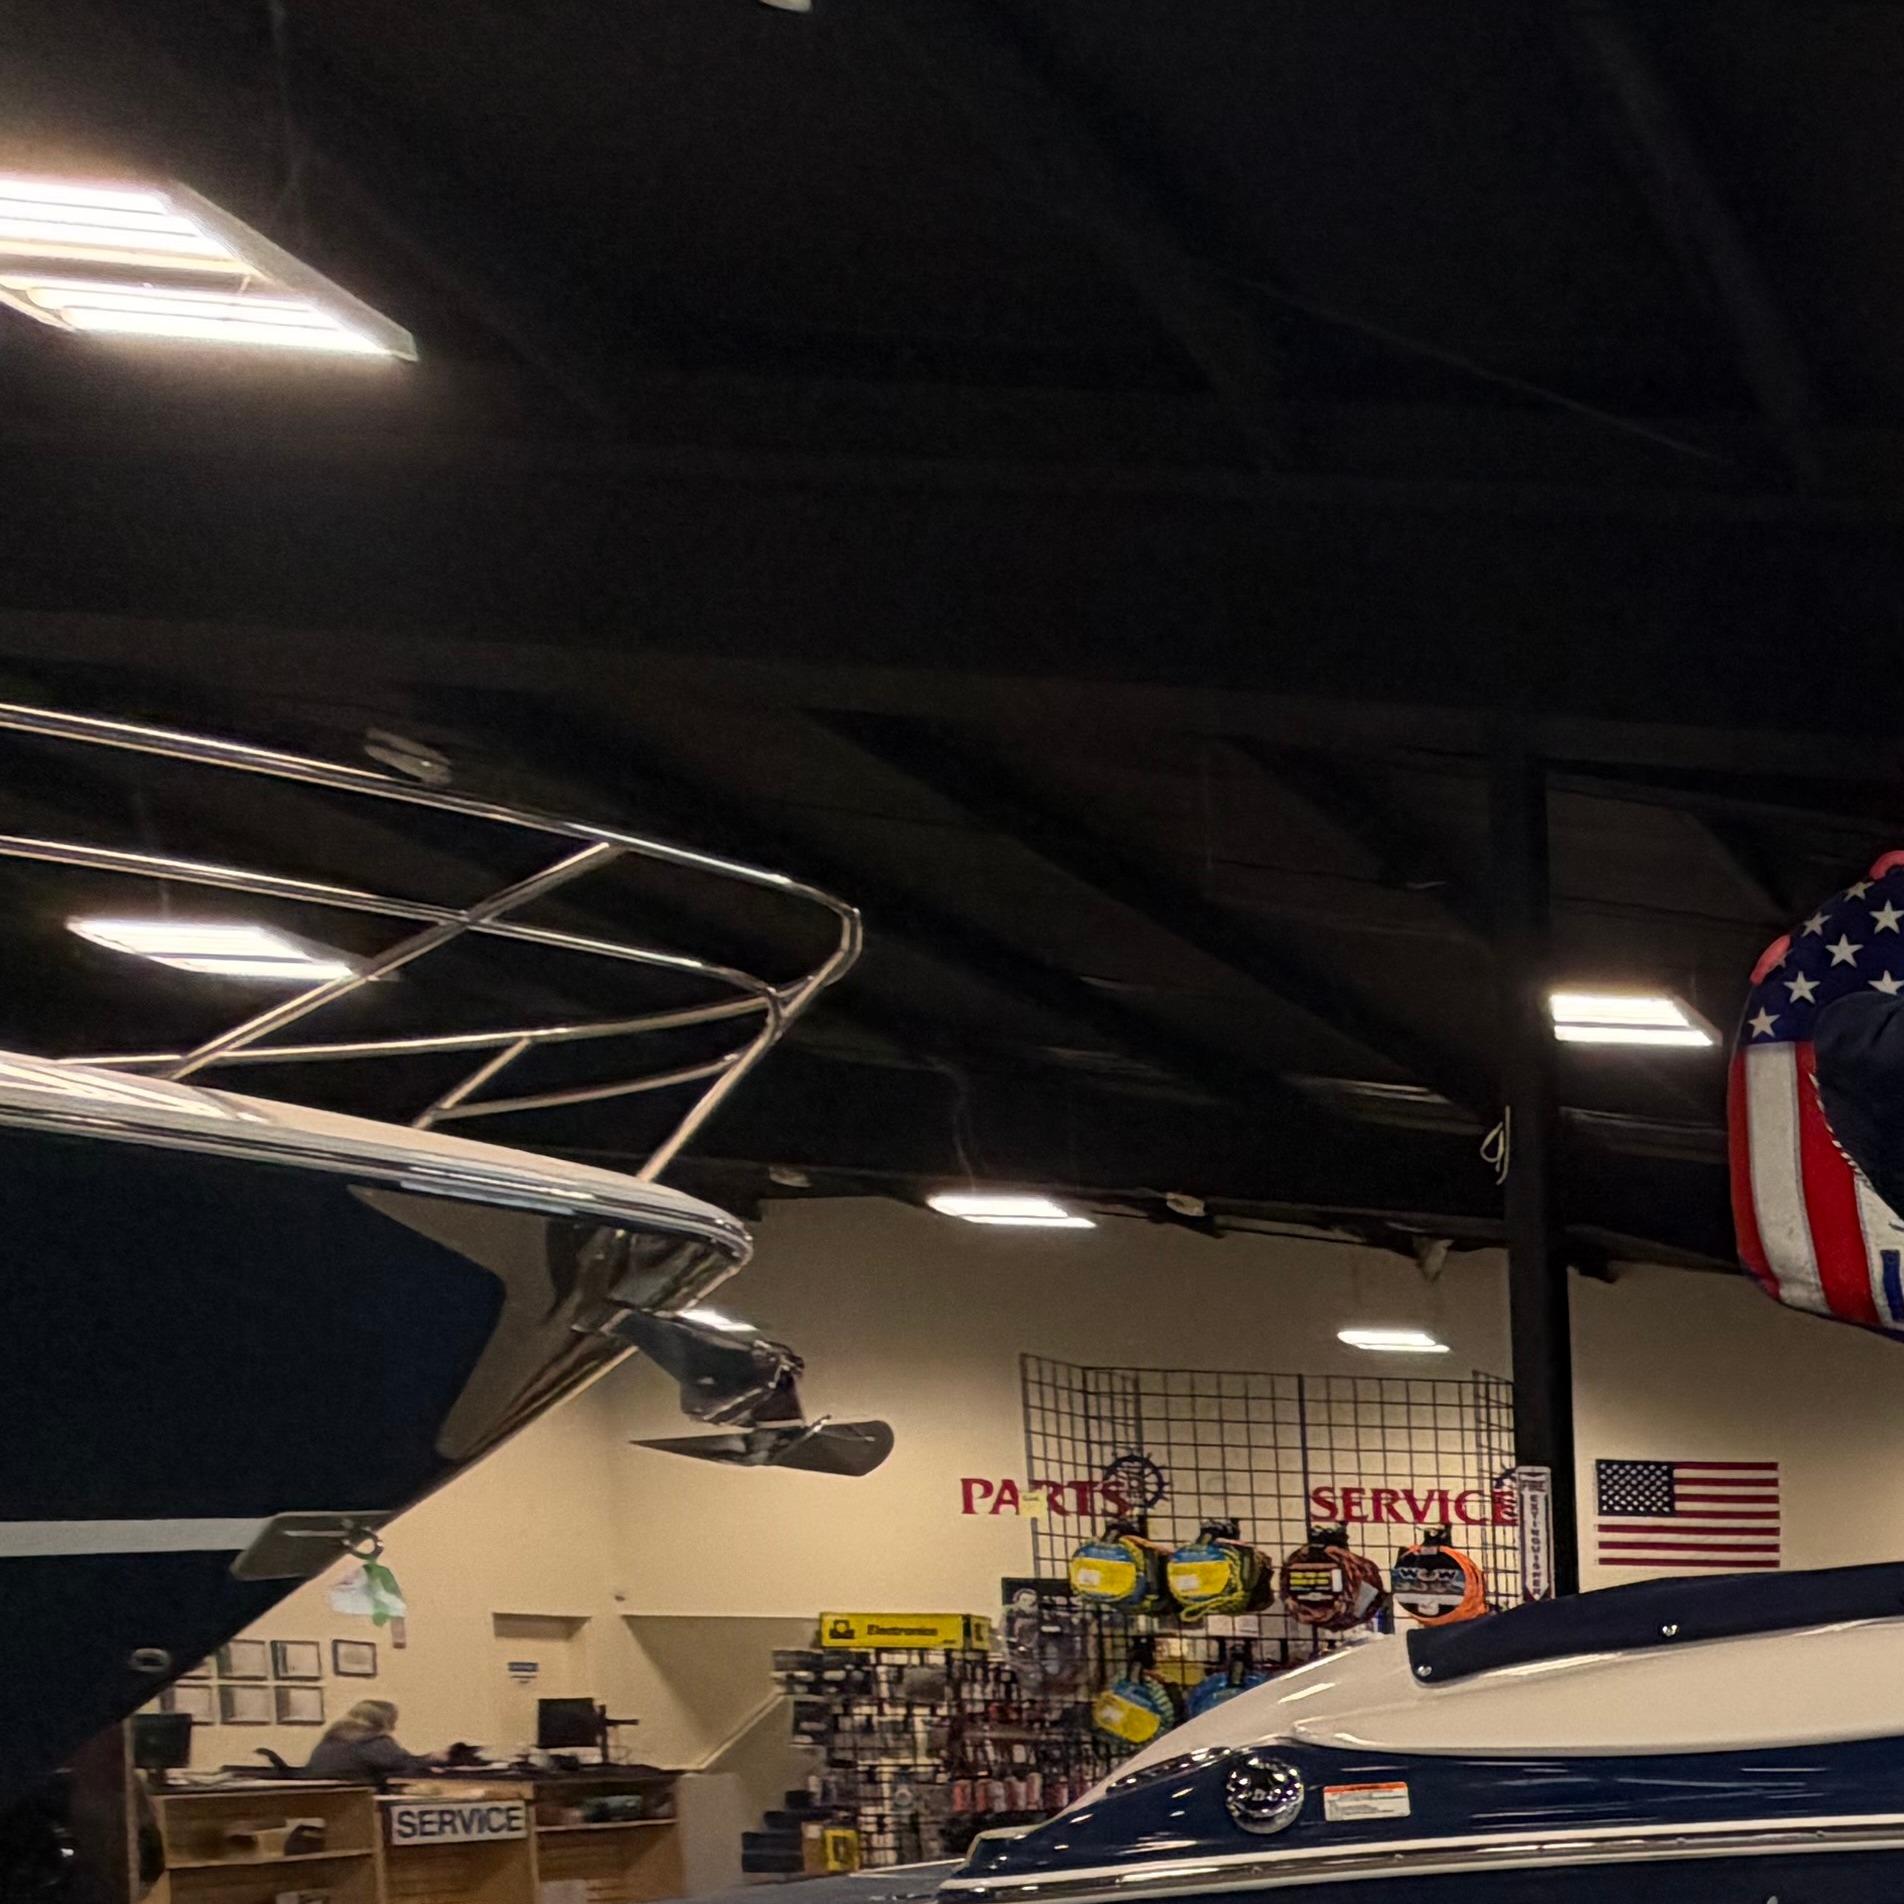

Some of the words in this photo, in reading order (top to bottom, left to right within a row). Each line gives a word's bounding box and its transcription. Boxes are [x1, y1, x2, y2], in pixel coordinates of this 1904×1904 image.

[960, 1478, 1134, 1518] PARTS
[1310, 1486, 1518, 1526] SERVICE
[397, 1806, 523, 1838] SERVICE
